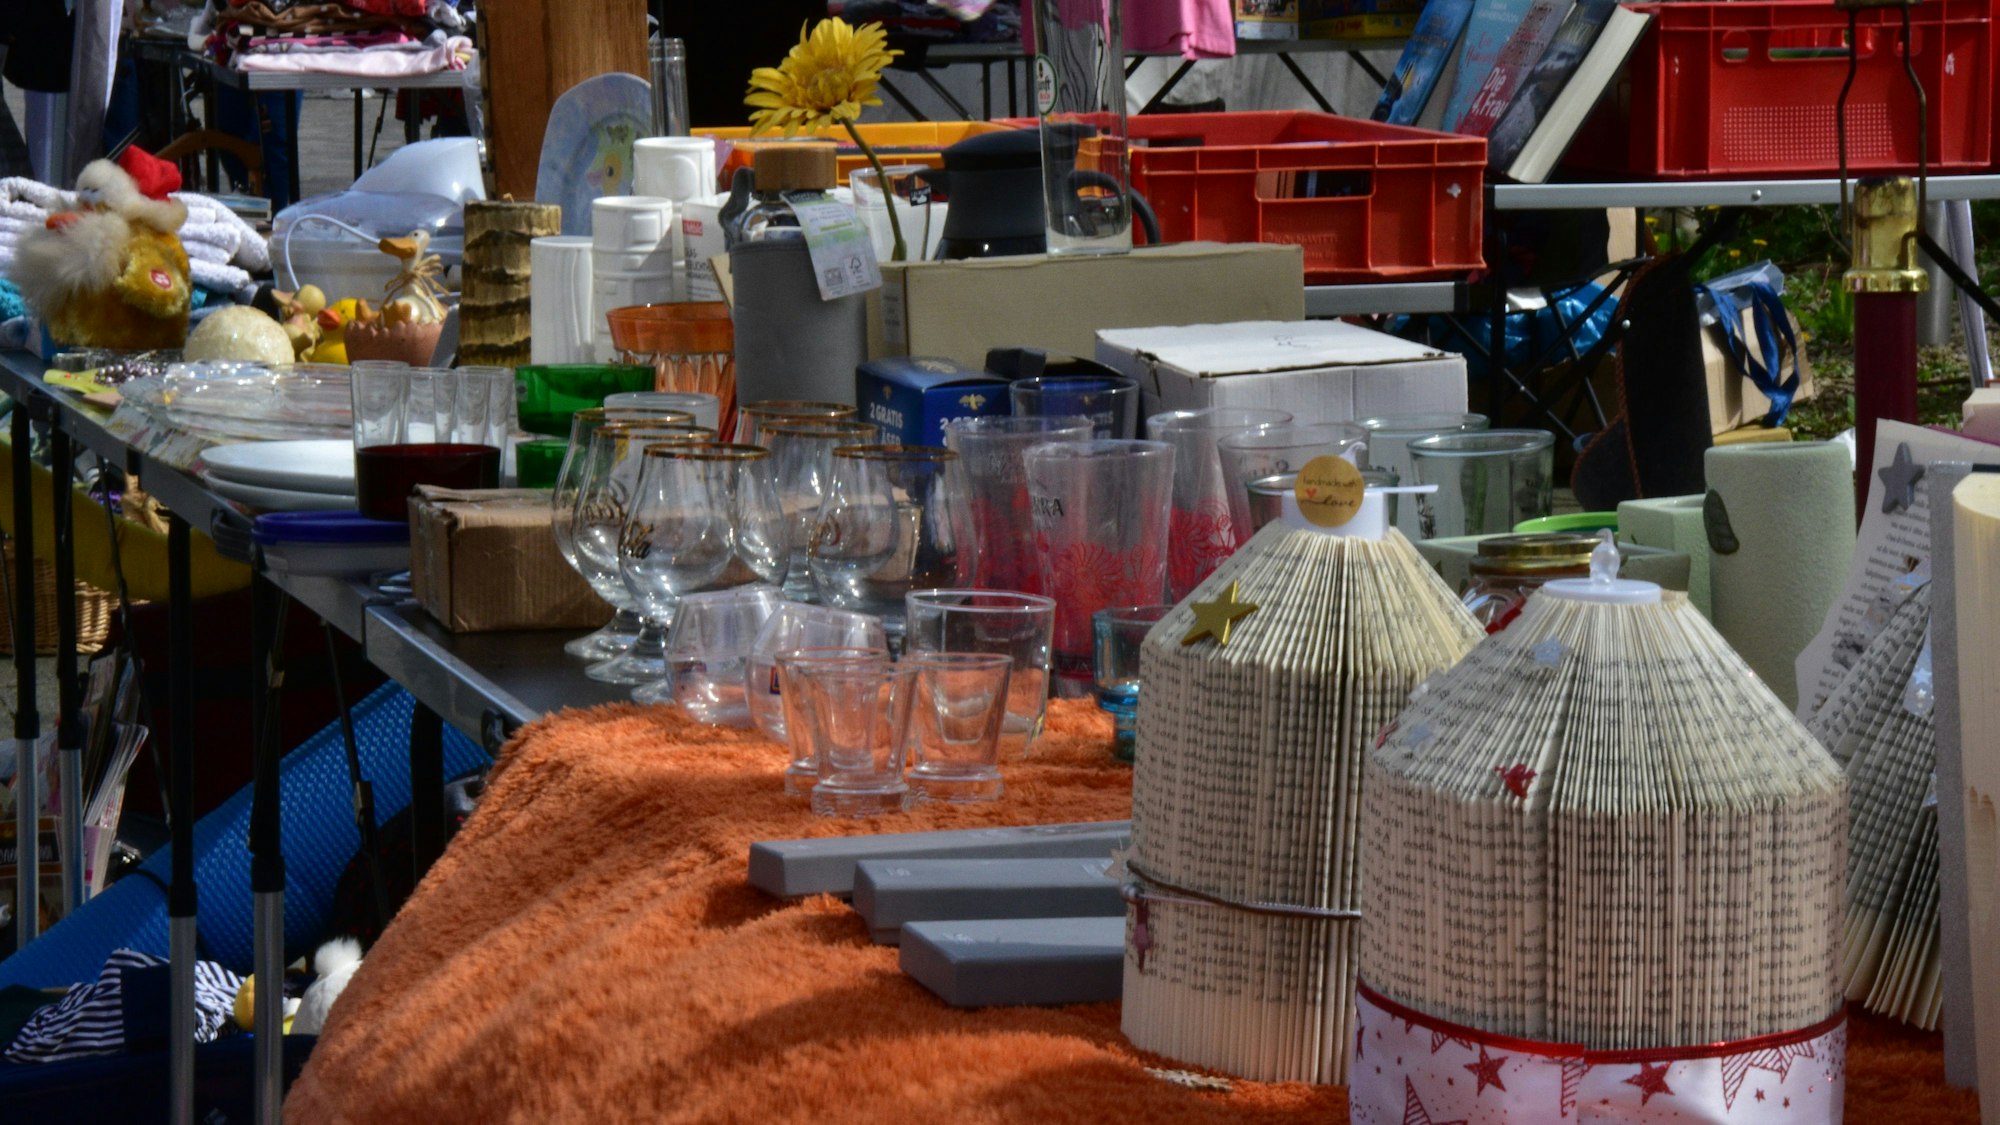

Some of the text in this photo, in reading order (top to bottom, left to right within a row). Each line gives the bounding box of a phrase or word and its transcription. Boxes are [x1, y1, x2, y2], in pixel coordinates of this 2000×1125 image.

[1483, 66, 1507, 92] Die
[869, 401, 904, 430] 2 GRATIS
